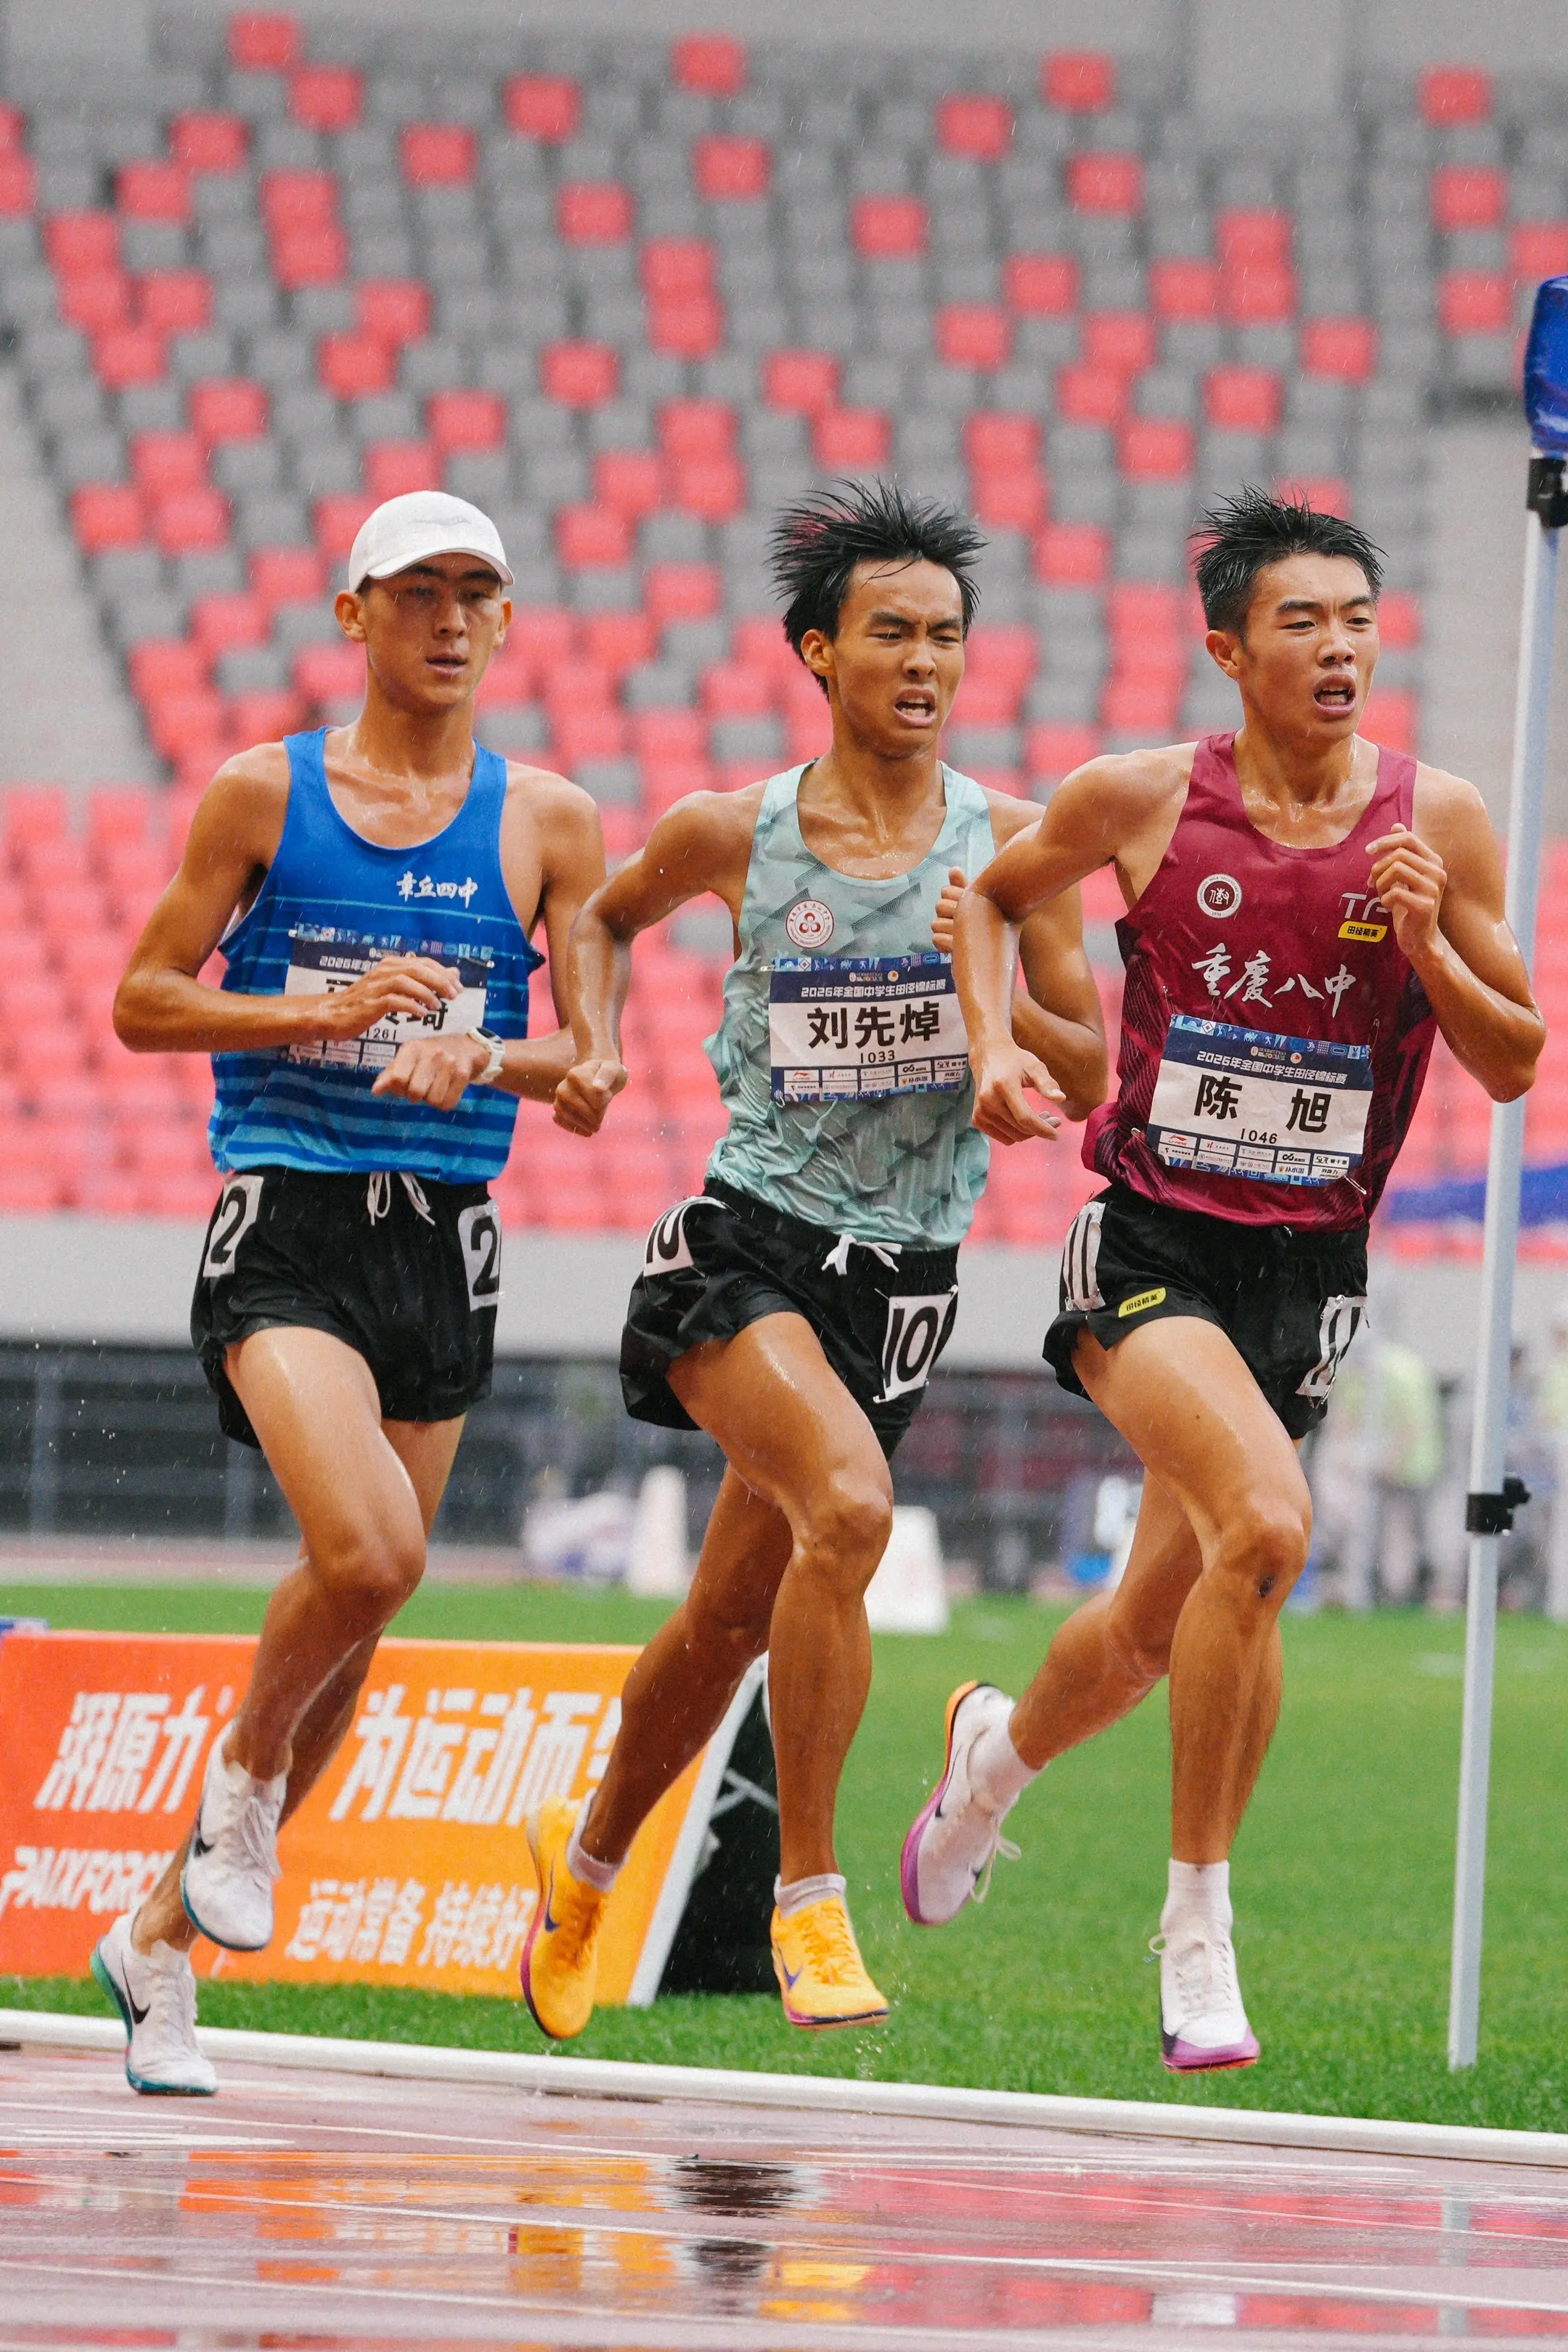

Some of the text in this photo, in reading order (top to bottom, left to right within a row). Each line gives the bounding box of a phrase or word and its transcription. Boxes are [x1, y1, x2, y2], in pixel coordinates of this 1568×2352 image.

[396, 870, 478, 909] 章丘四中
[801, 979, 947, 997] 2026年全国中学生田径锦标赛
[807, 1001, 940, 1049] 刘先焯
[859, 1050, 896, 1063] 1033
[1196, 1050, 1347, 1085] 2026年全国中学生田径锦标赛
[1241, 1128, 1278, 1144] 1046
[211, 1185, 248, 1264] 2
[470, 1216, 499, 1297] 2
[882, 1306, 939, 1387] 10
